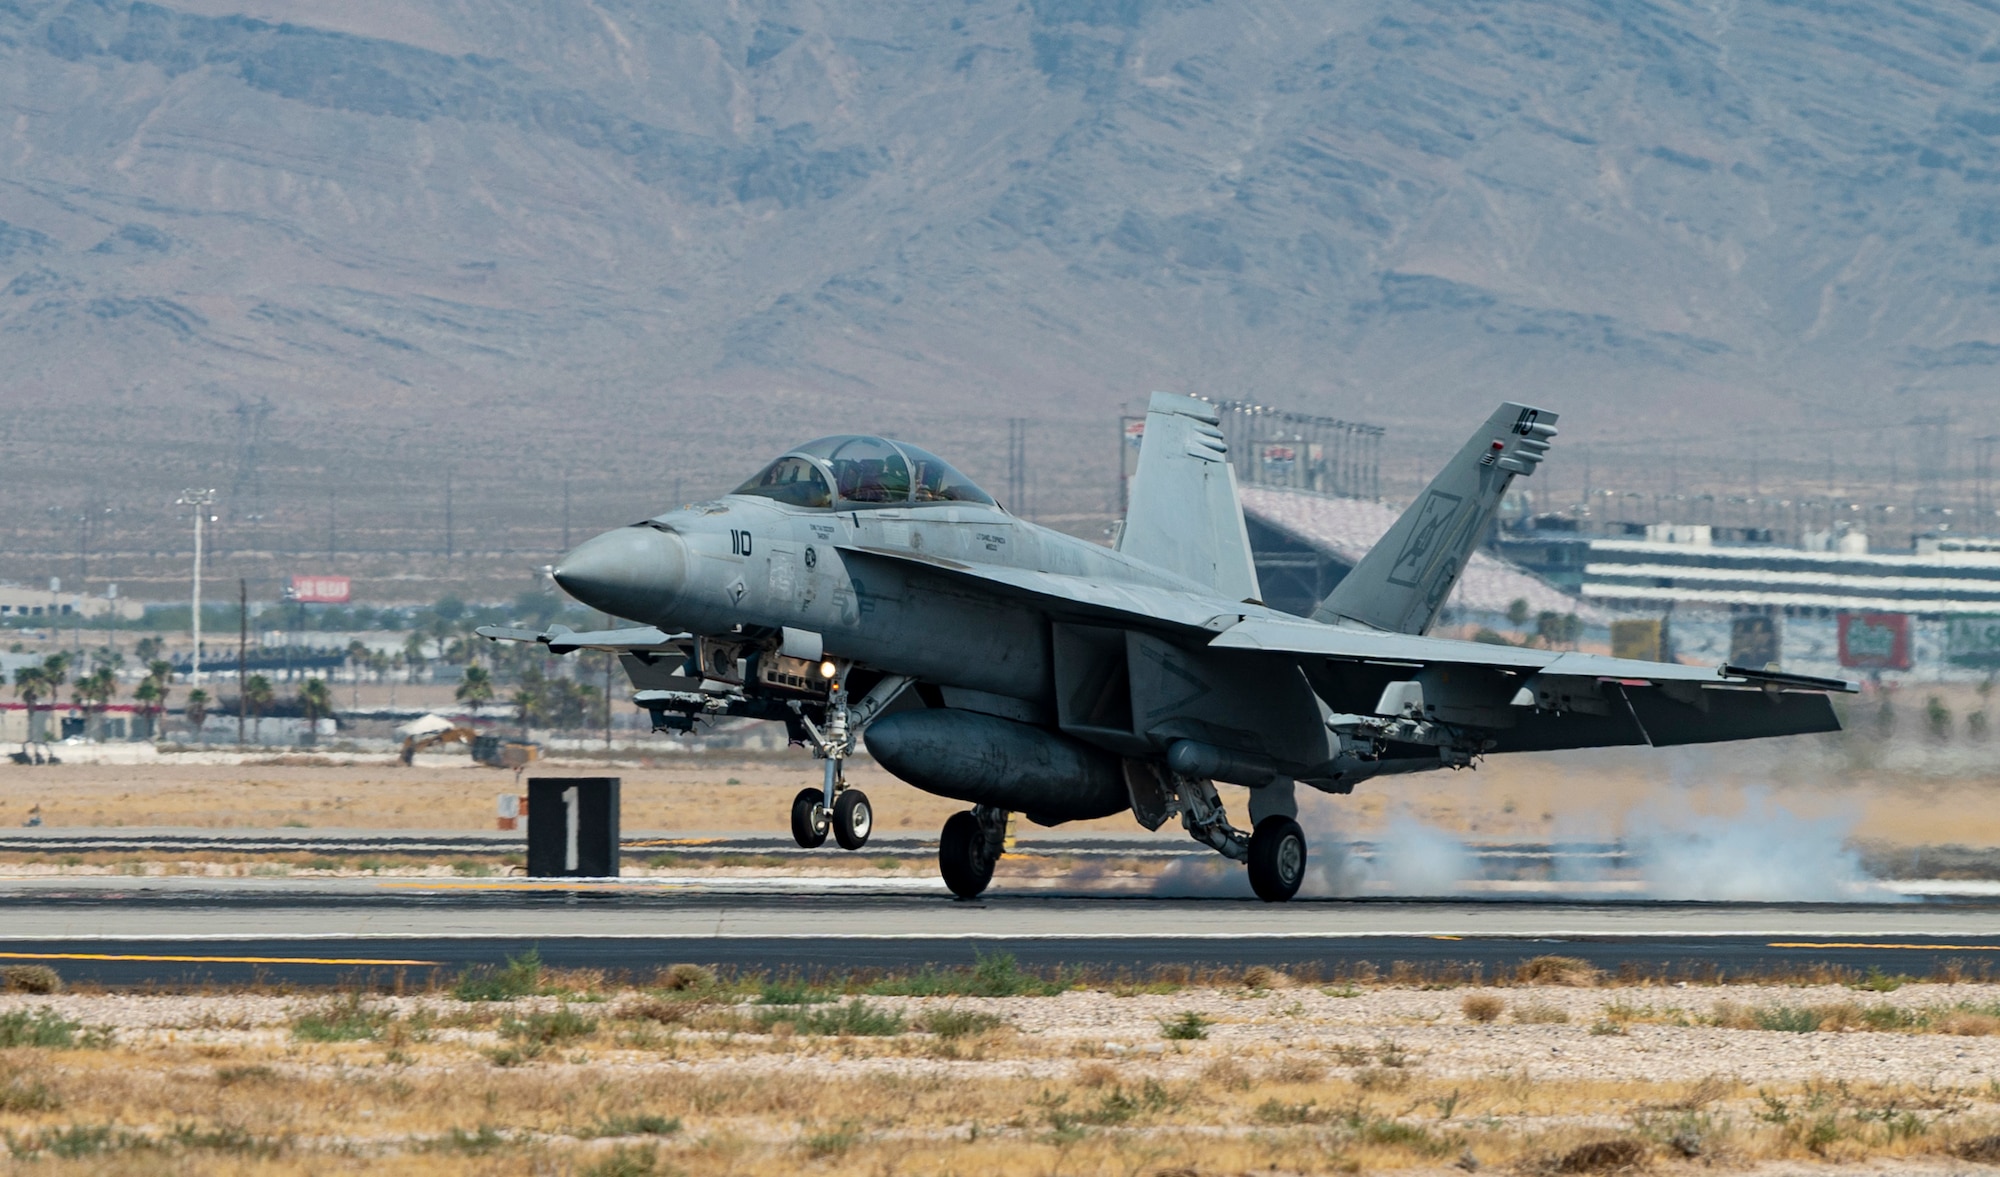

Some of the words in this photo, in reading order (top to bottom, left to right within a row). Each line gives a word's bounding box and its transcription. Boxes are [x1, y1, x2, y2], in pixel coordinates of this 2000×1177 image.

[1511, 407, 1538, 436] 110
[730, 529, 752, 557] 110
[561, 785, 579, 871] 1
